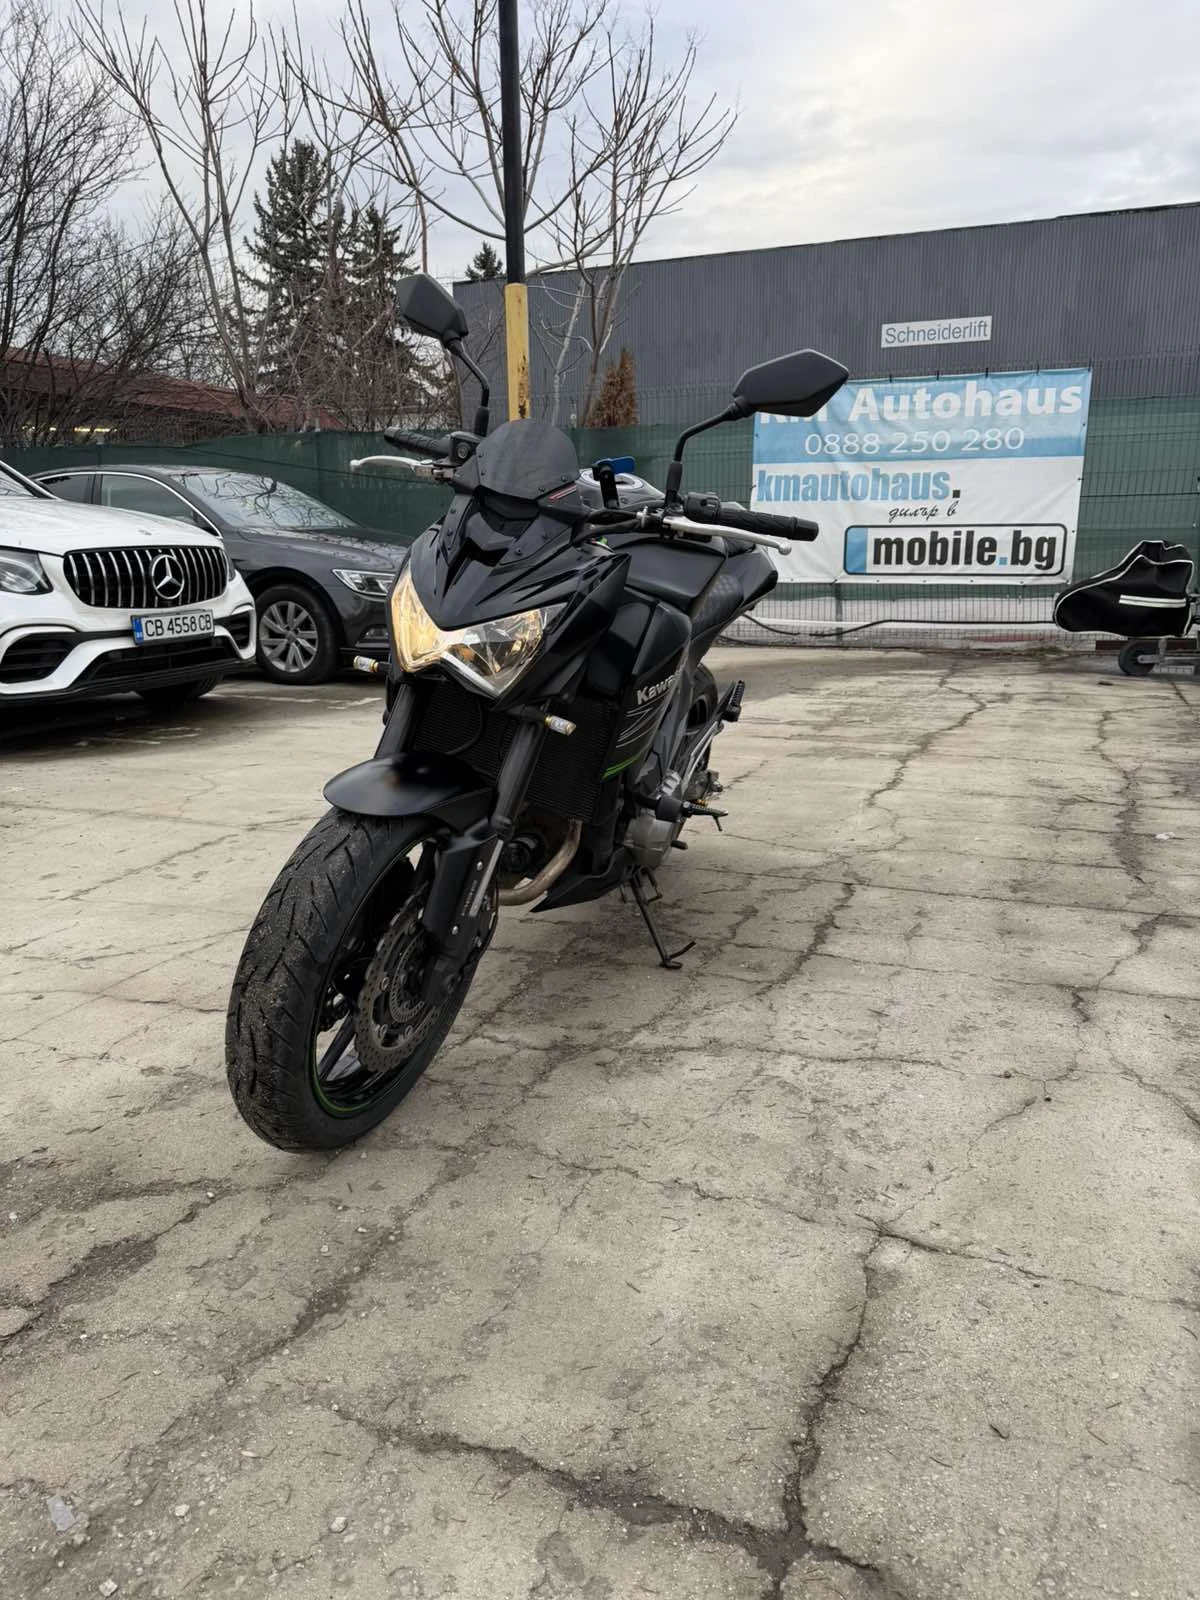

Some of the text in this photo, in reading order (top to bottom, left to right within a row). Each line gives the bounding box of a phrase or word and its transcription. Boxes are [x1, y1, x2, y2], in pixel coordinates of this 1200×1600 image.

[885, 320, 988, 344] Schneiderlift
[848, 381, 1082, 422] Autohaus
[804, 427, 1025, 456] 0888 250 280
[888, 504, 939, 523] дилър
[873, 530, 1057, 570] mobile.bg
[145, 614, 212, 637] CB 4558 CB
